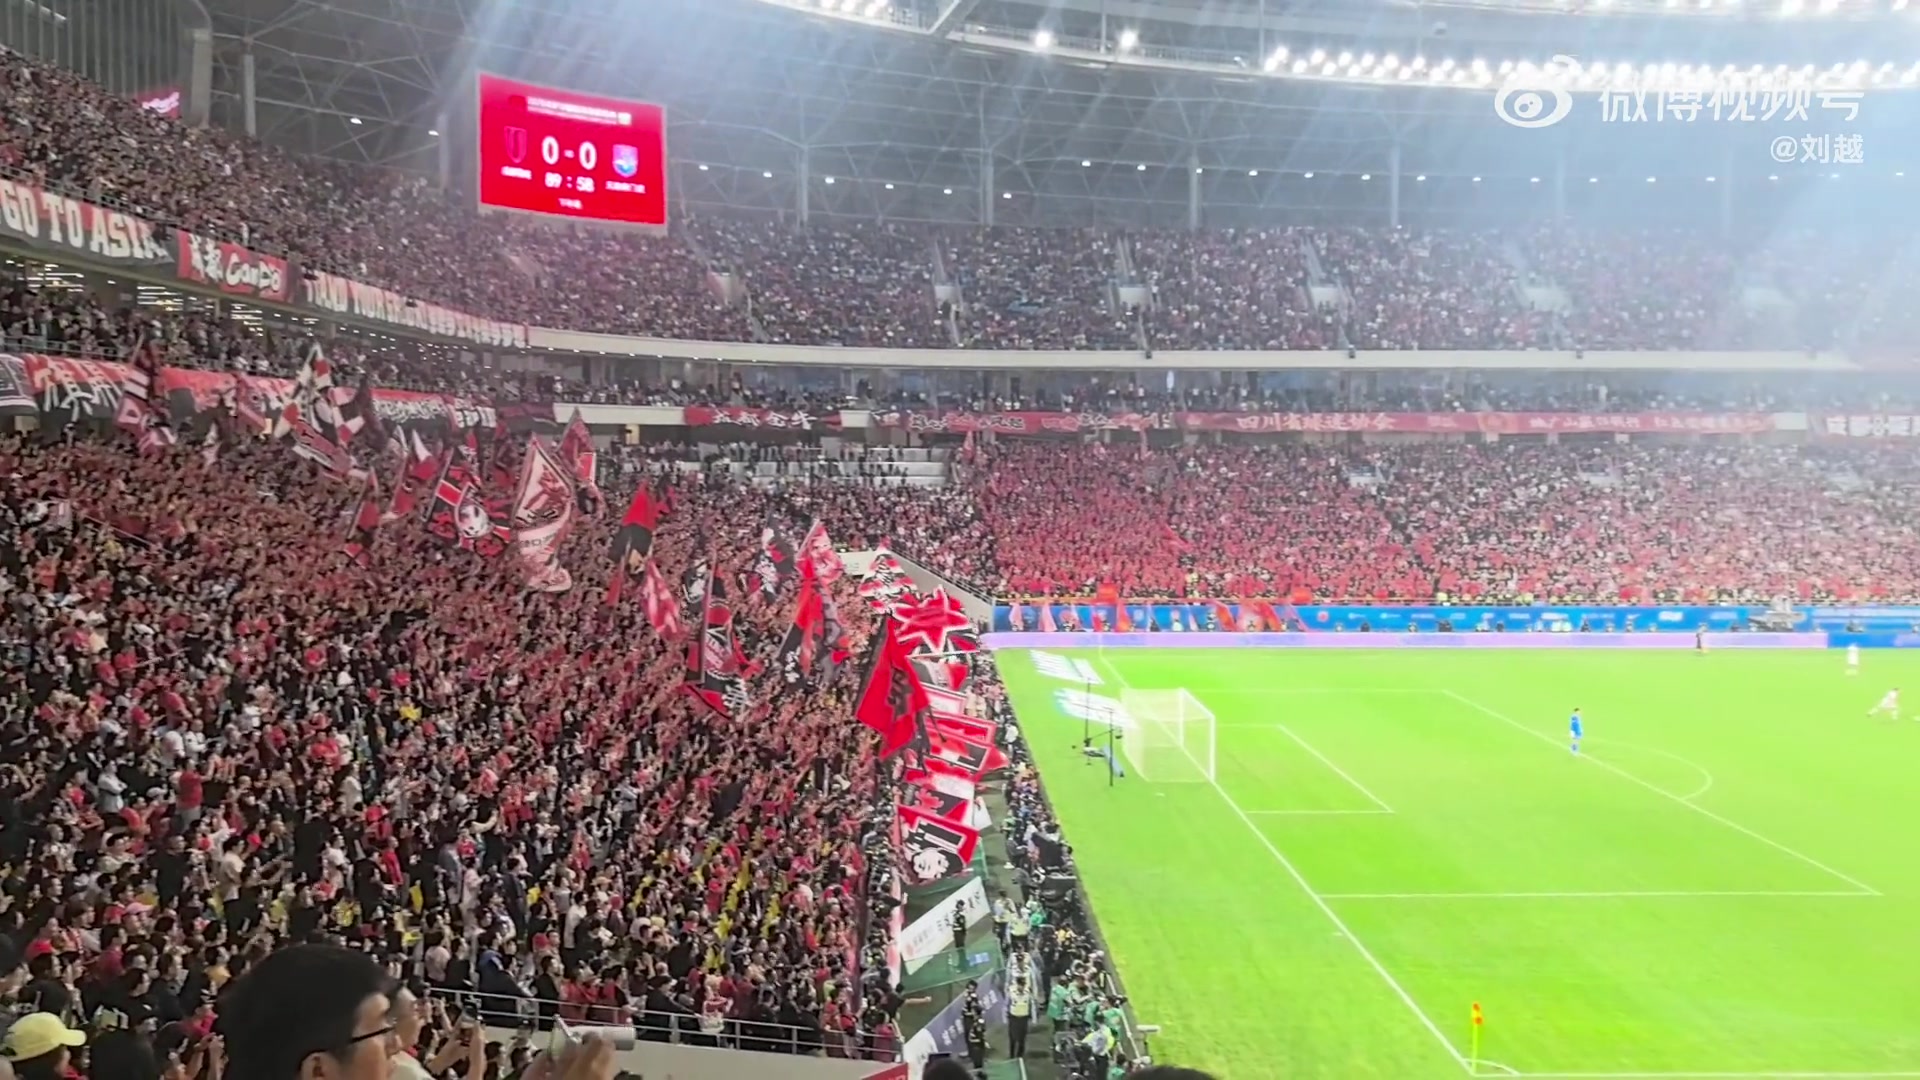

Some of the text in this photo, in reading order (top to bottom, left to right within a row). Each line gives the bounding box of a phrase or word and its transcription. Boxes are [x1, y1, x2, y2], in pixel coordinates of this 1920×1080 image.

[0, 179, 168, 259] GO TO ASIA
